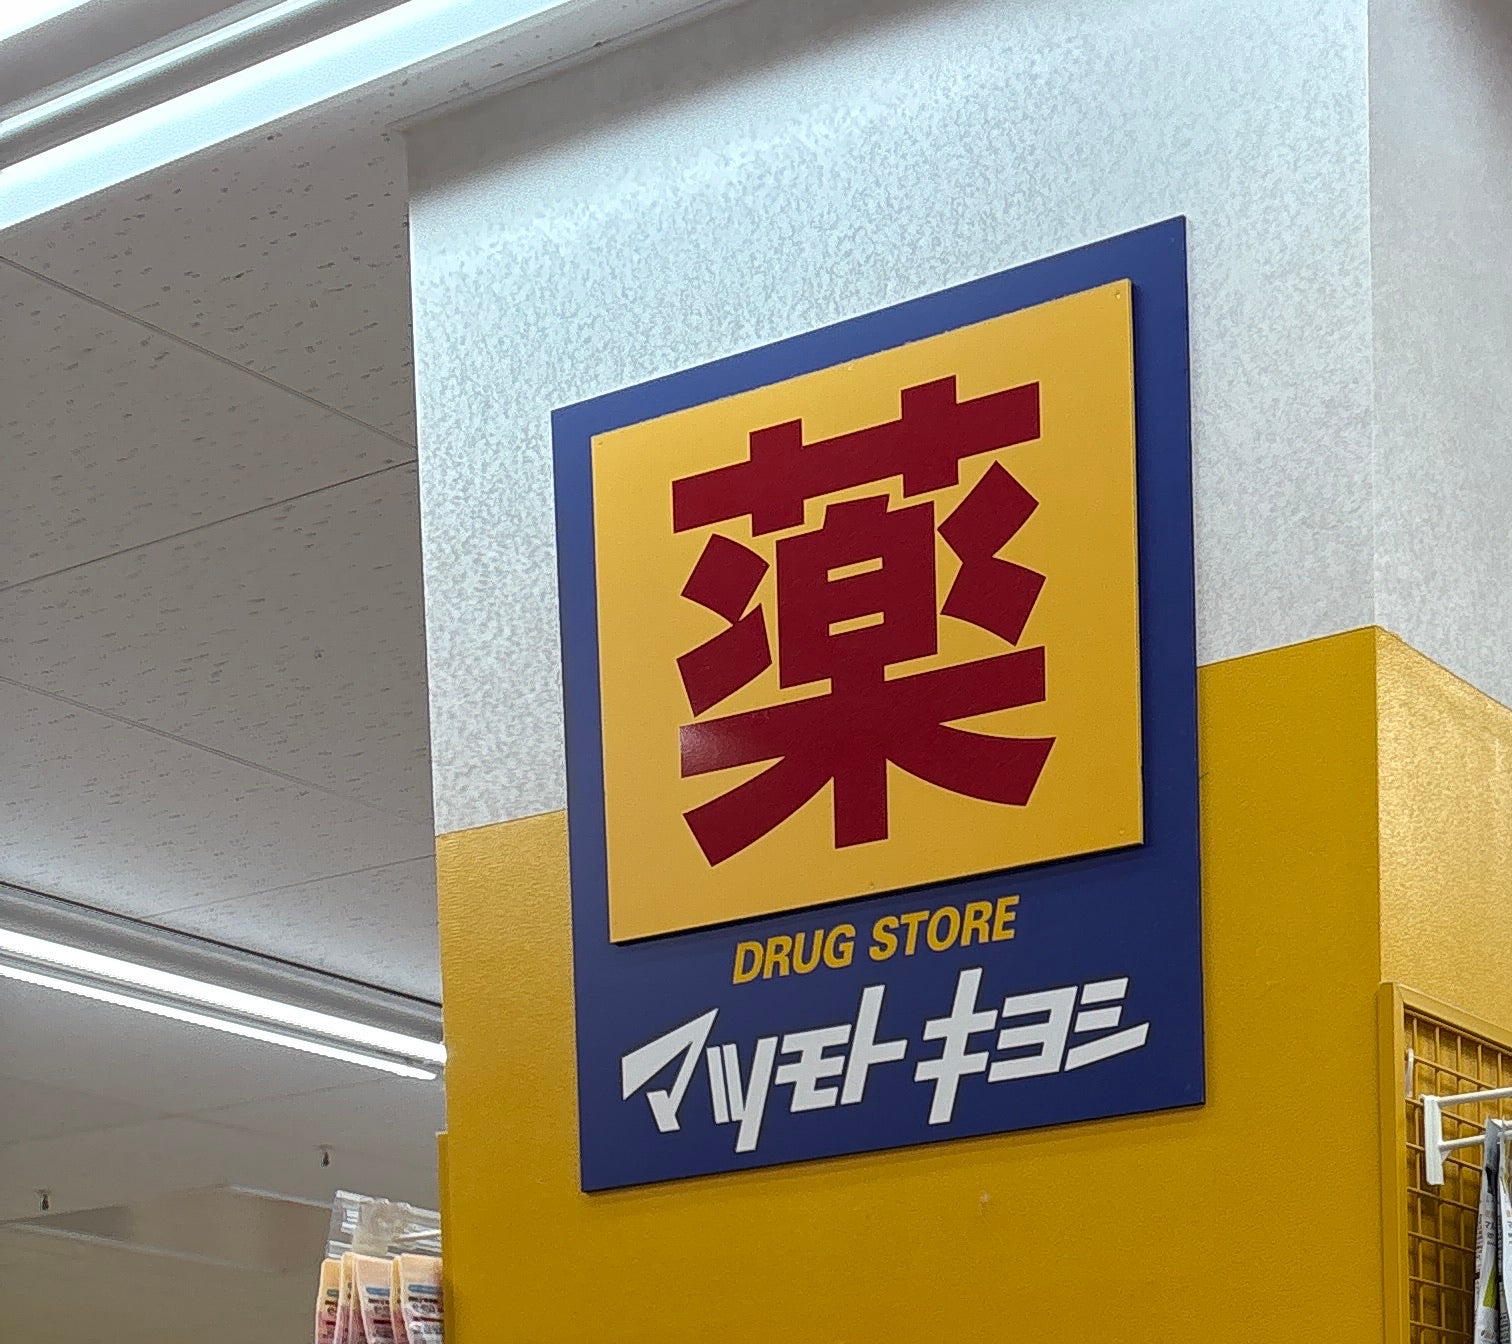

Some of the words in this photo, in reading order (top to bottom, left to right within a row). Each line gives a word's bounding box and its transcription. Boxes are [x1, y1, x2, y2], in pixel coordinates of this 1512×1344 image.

[672, 375, 1056, 866] 薬
[733, 919, 854, 985] DRUG
[870, 896, 1021, 960] STORE
